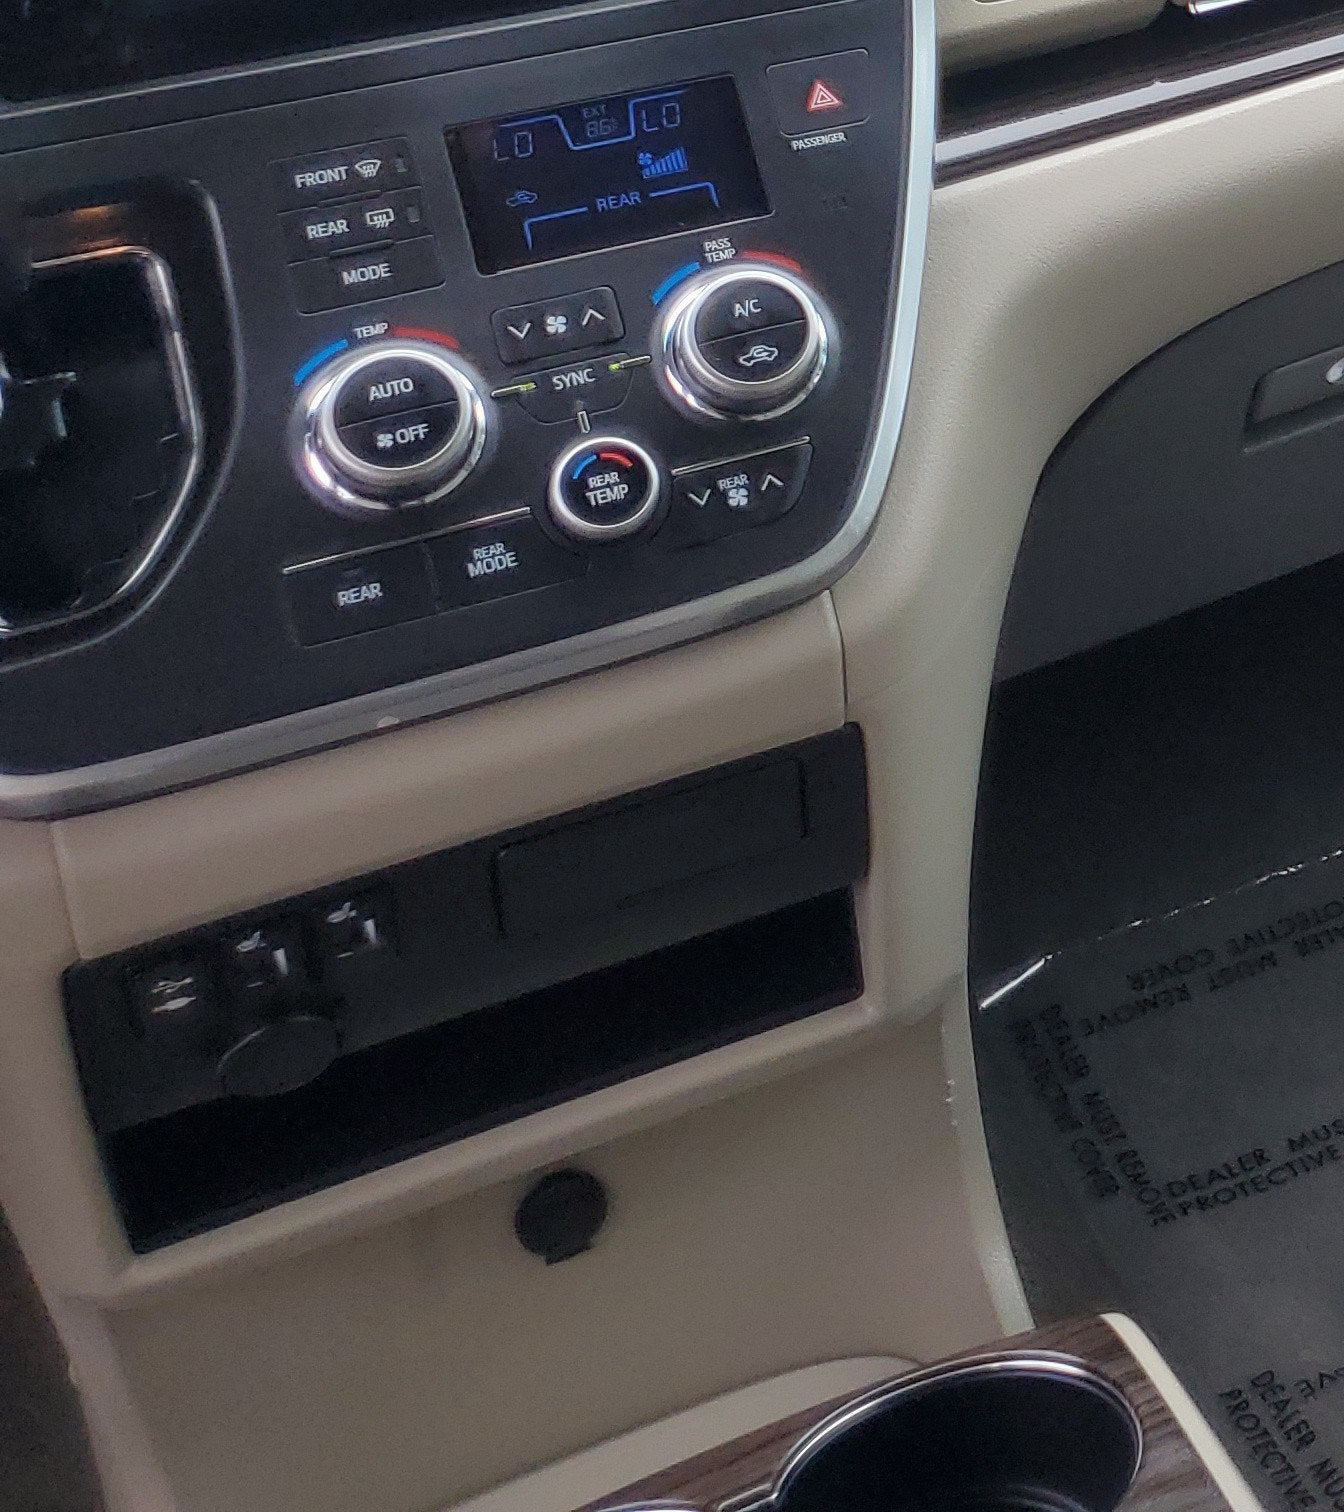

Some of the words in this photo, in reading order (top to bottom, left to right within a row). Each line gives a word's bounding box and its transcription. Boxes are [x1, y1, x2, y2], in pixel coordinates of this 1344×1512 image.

[791, 131, 848, 152] PASSENGER
[294, 162, 349, 192] FRONT
[595, 191, 643, 214] REAR
[306, 217, 349, 241] REAR
[704, 237, 733, 252] PASS
[705, 246, 737, 263] TEMP
[342, 261, 394, 286] MODE
[733, 297, 763, 319] A/C
[353, 321, 389, 340] TEMP
[368, 377, 415, 402] AUTO
[551, 365, 597, 391] SYNC
[395, 422, 430, 446] OFF
[588, 471, 622, 489] REAR
[717, 473, 749, 492] REAR
[585, 481, 631, 507] TEMP
[472, 542, 507, 561] REAR
[466, 551, 519, 578] MODE
[336, 581, 383, 607] REAR
[1165, 1146, 1272, 1200] DEALER
[1179, 1142, 1342, 1219] PROTECTIVE
[1250, 1369, 1317, 1453] DEALER
